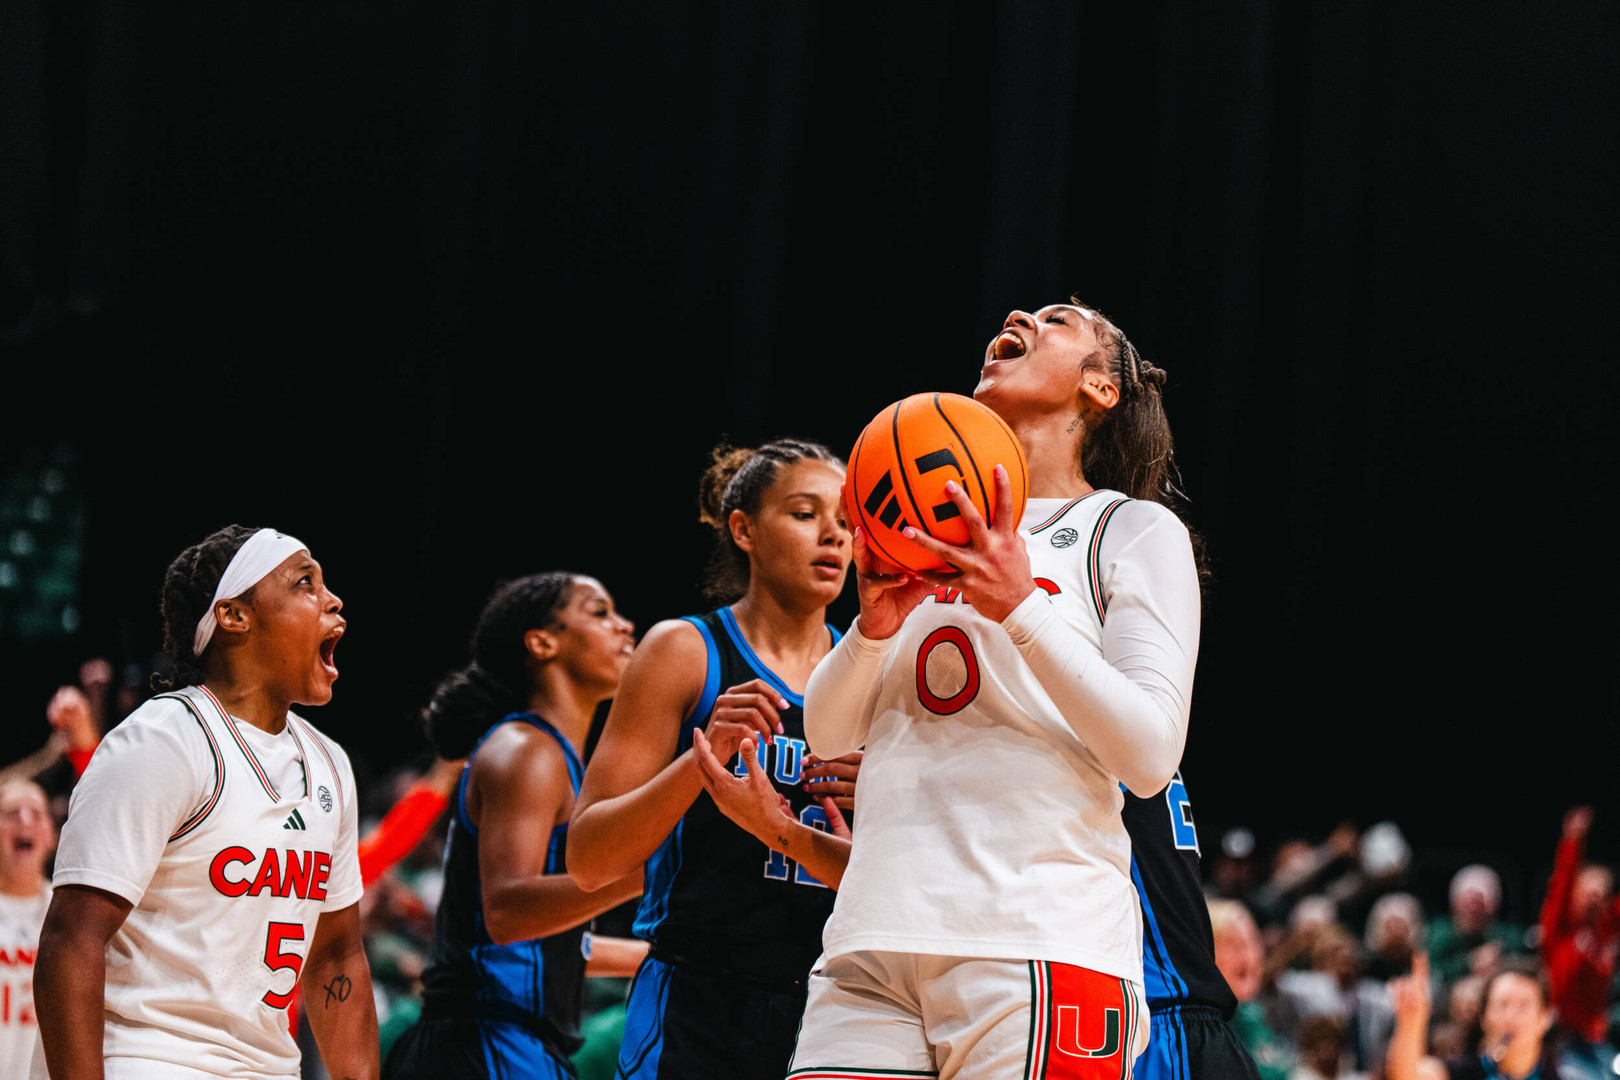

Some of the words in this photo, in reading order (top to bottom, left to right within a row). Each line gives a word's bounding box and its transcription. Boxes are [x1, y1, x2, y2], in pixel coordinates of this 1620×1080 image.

[735, 731, 838, 786] DU
[209, 846, 332, 902] CANE
[261, 921, 304, 1010] 5
[323, 974, 352, 1009] XO
[1056, 1005, 1120, 1058] U
